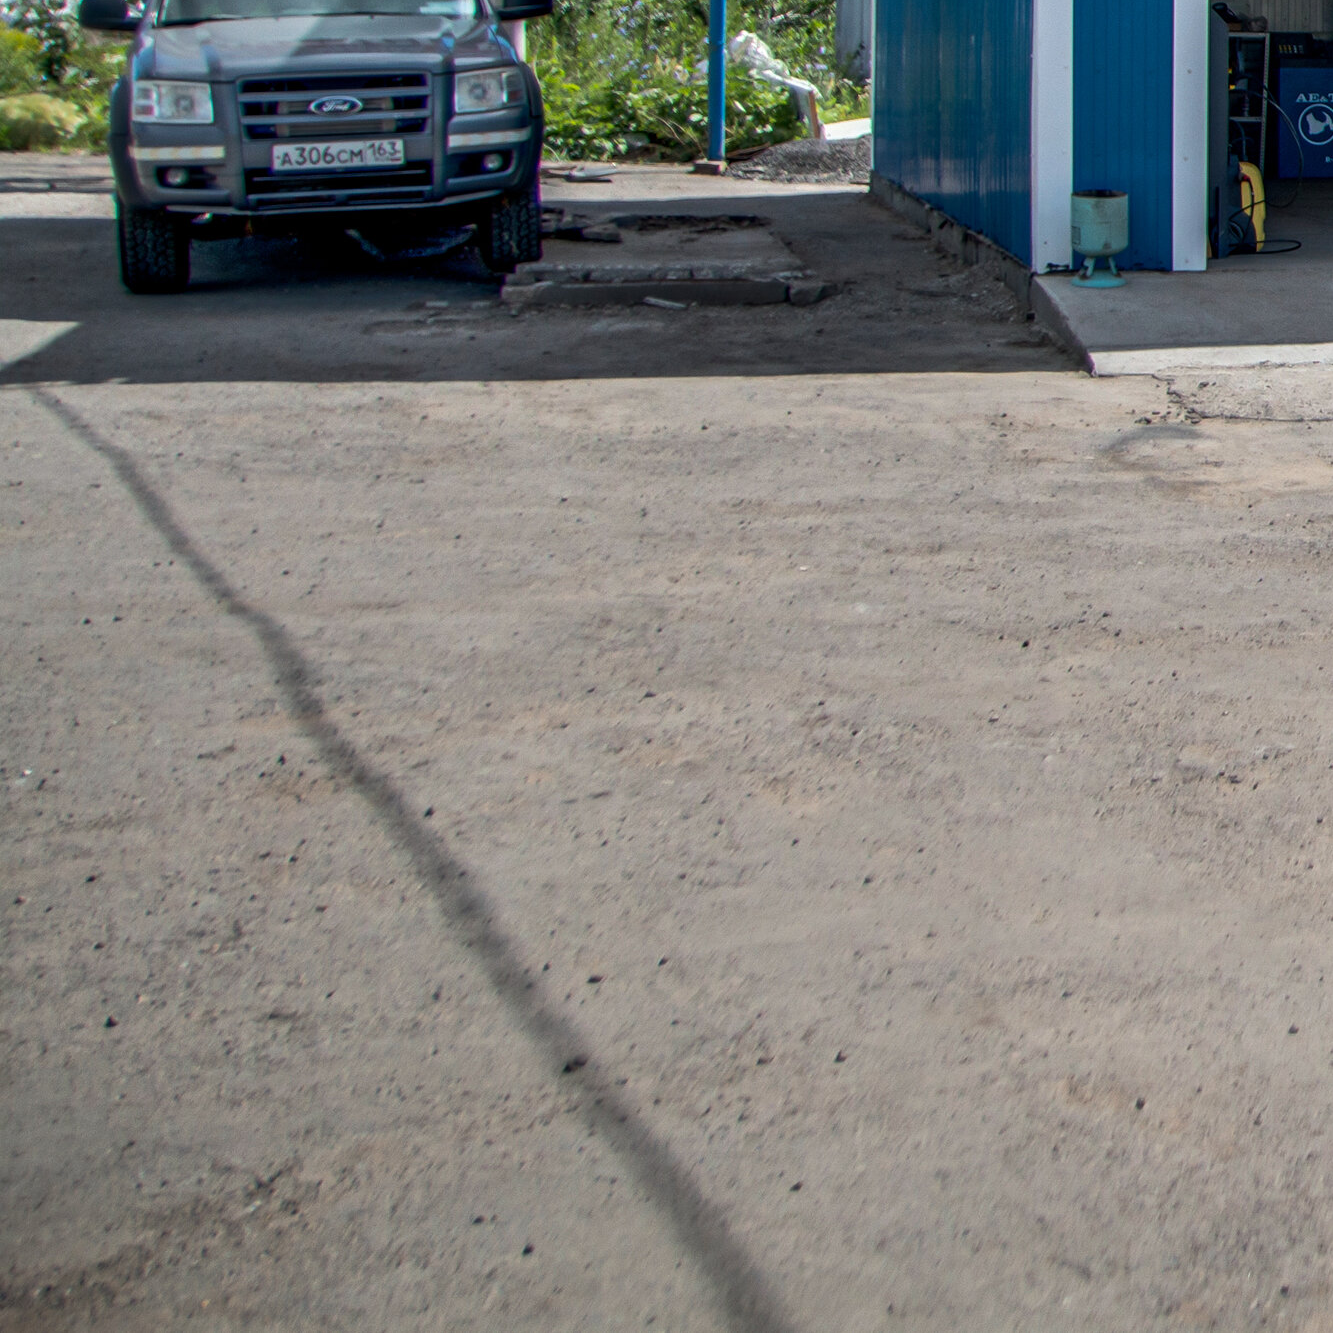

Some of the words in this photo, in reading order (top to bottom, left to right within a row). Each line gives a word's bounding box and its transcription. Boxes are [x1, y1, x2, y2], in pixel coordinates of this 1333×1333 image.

[322, 99, 350, 112] Ford
[281, 146, 363, 166] А306СМ
[368, 141, 399, 158] 163
